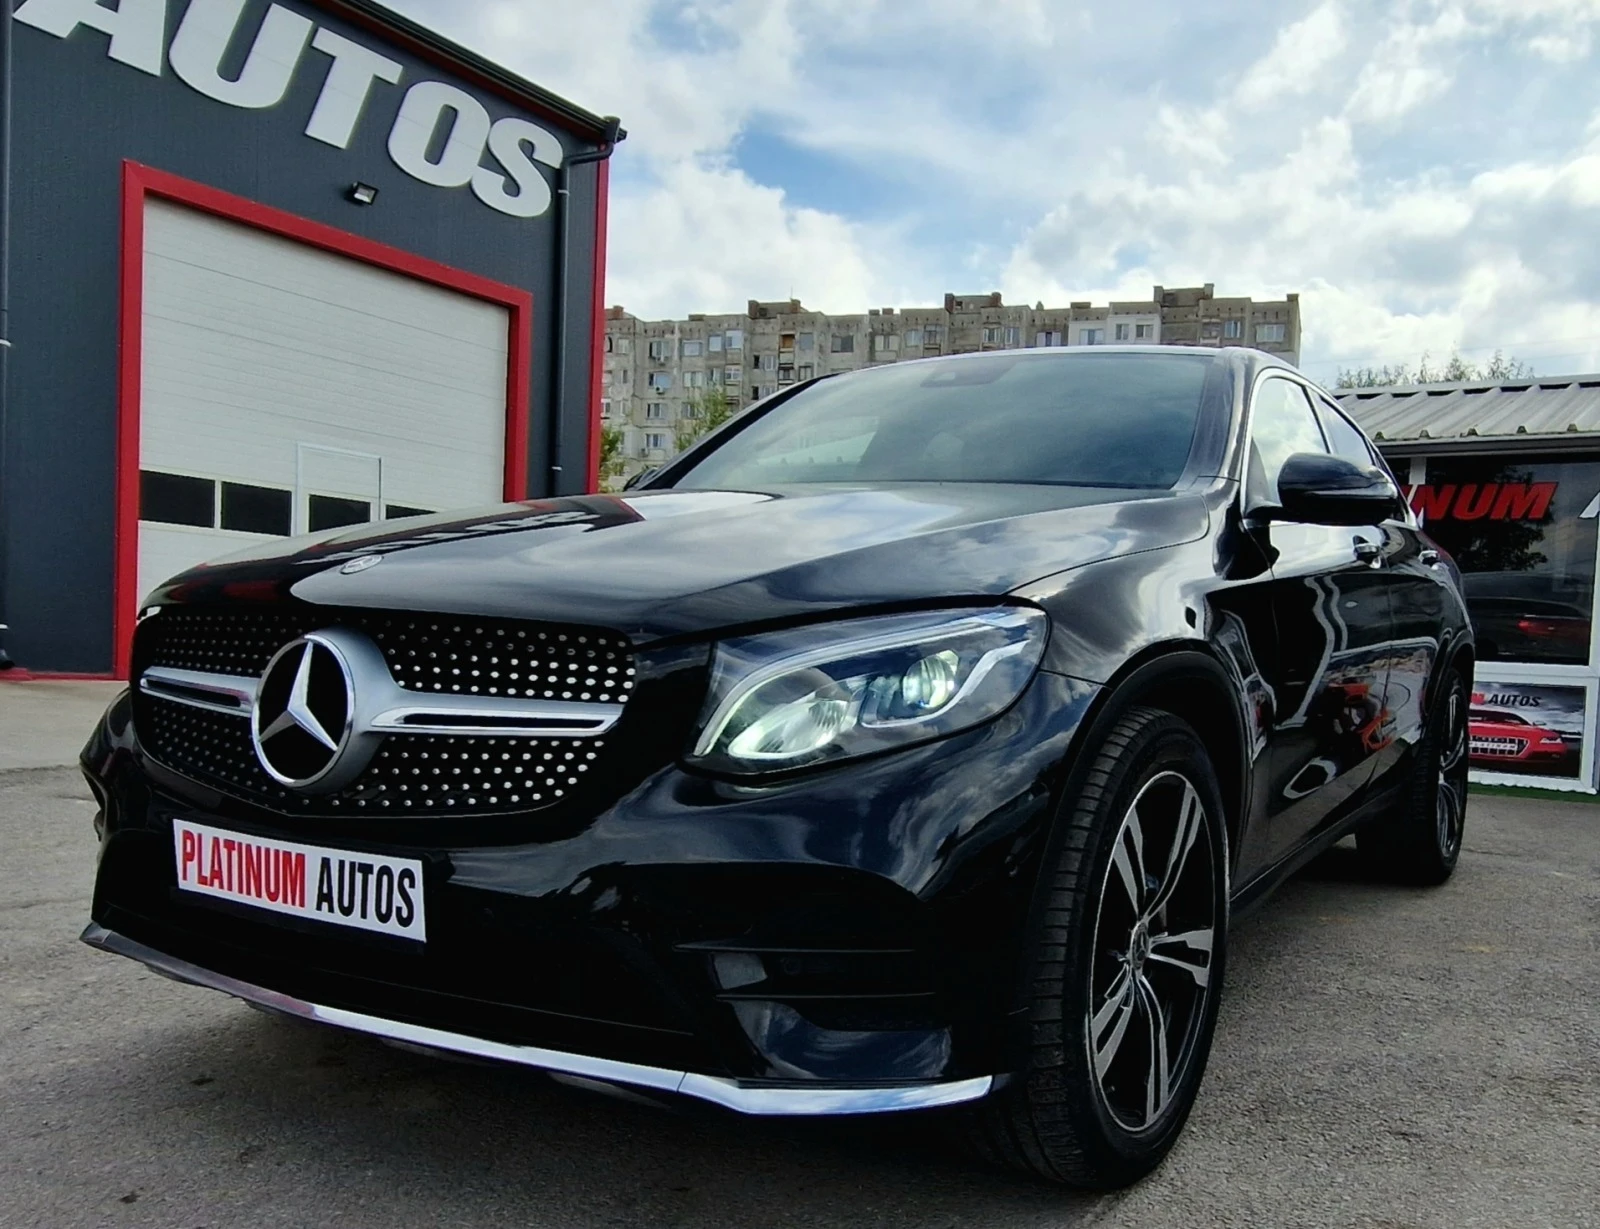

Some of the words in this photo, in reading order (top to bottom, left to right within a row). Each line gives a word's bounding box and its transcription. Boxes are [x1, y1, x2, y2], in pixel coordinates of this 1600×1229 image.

[1489, 694, 1542, 707] AUTOS
[182, 829, 306, 909] PLATINUM
[316, 856, 416, 929] AUTOS
